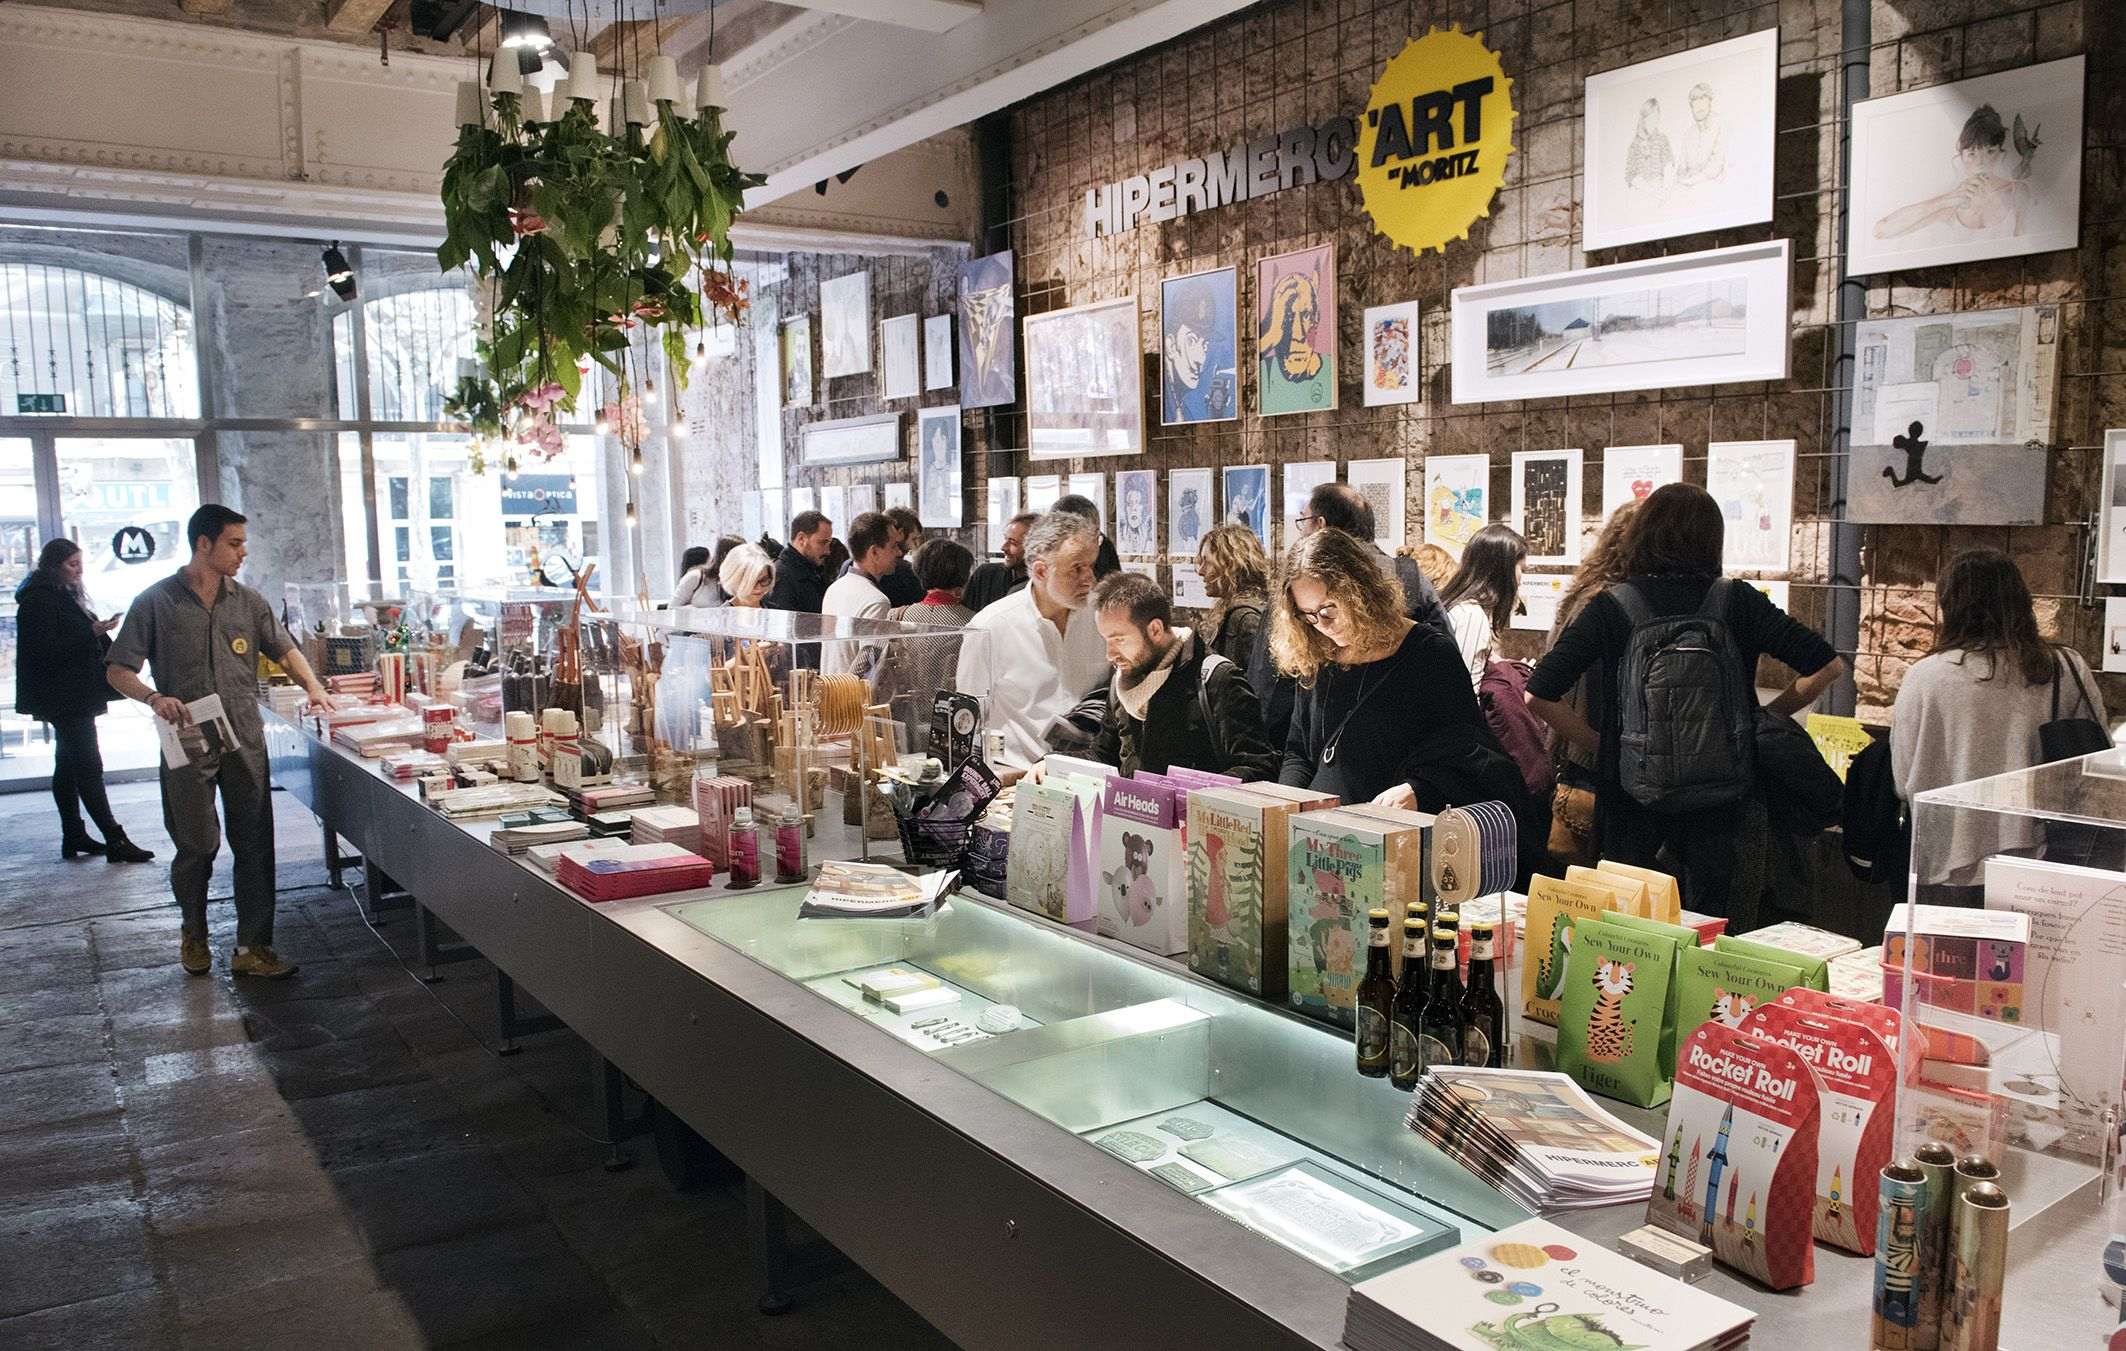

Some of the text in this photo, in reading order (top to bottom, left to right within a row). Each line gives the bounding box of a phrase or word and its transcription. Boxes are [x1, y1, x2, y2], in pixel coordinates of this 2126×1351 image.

[1400, 150, 1480, 190] MORITZ
[120, 531, 150, 559] M
[1113, 791, 1128, 806] Air
[1128, 794, 1160, 815] Heads
[1209, 812, 1233, 829] Little
[1327, 841, 1362, 861] Three
[1305, 852, 1362, 882] Little Pigs
[1536, 890, 1552, 902] Sew
[1554, 893, 1573, 906] Your
[1575, 899, 1597, 913] Own
[1584, 934, 1661, 961] Sew Your Own
[1697, 965, 1785, 993] Sew Your Own
[1526, 1000, 1560, 1019] Croc
[1752, 1027, 1873, 1076] Rket Roll
[1784, 1029, 1870, 1048] MAKE YOUR OWN 3+
[1580, 1064, 1621, 1089] Tiger
[1689, 1044, 1797, 1101] Rocket Roll
[1752, 1060, 1767, 1070] OWN
[1785, 1061, 1796, 1070] 3+
[1545, 1154, 1640, 1168] HIPERMERC
[1560, 1266, 1671, 1316] el monstruo
[1583, 1288, 1635, 1315] colores
